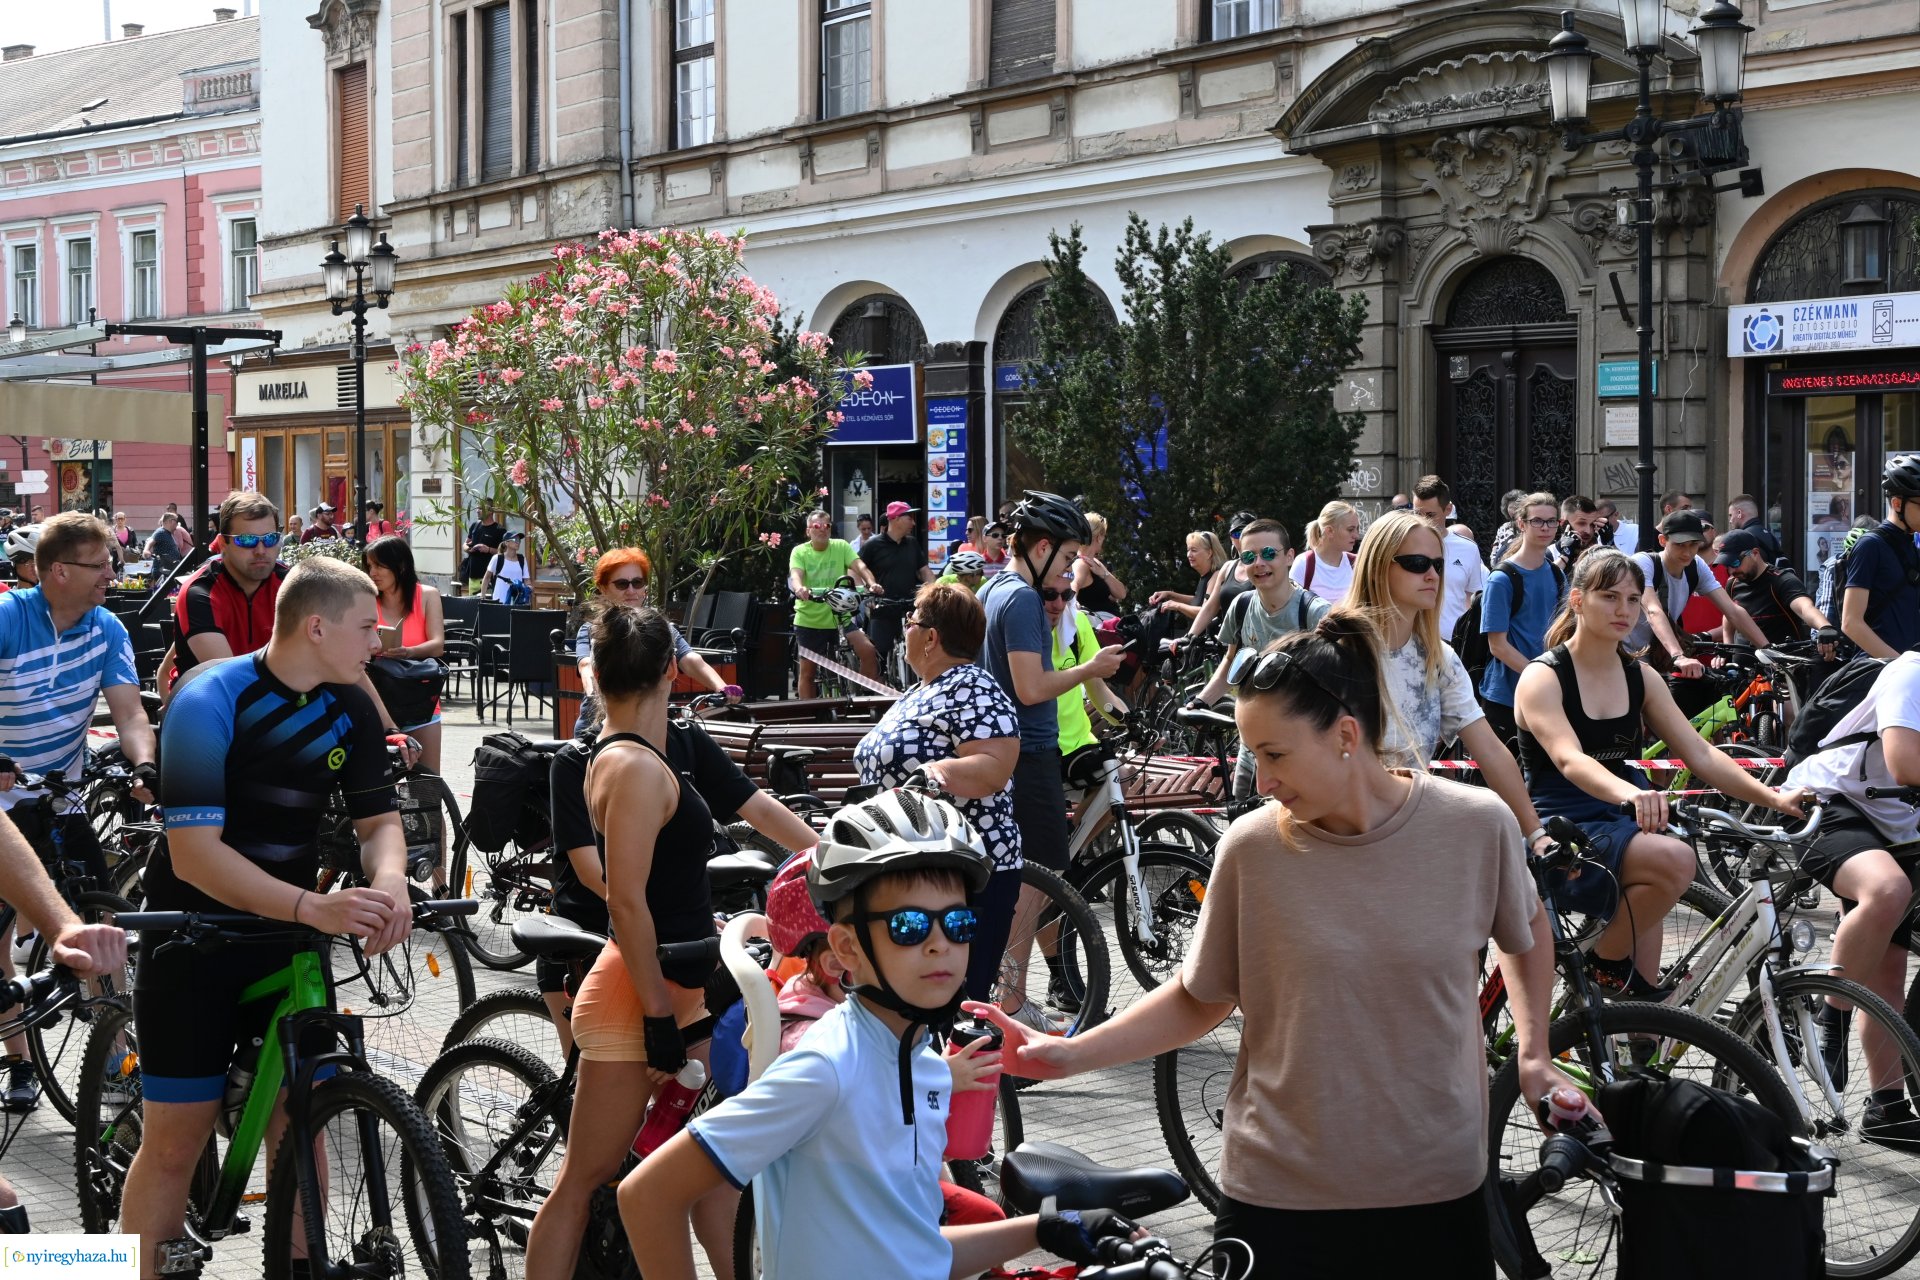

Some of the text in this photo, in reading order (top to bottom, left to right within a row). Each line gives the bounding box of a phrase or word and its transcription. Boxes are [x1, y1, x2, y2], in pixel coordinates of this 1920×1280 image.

[1793, 303, 1858, 322] CZÉKMANN
[258, 380, 308, 401] MARELLA
[840, 390, 893, 408] EDEON
